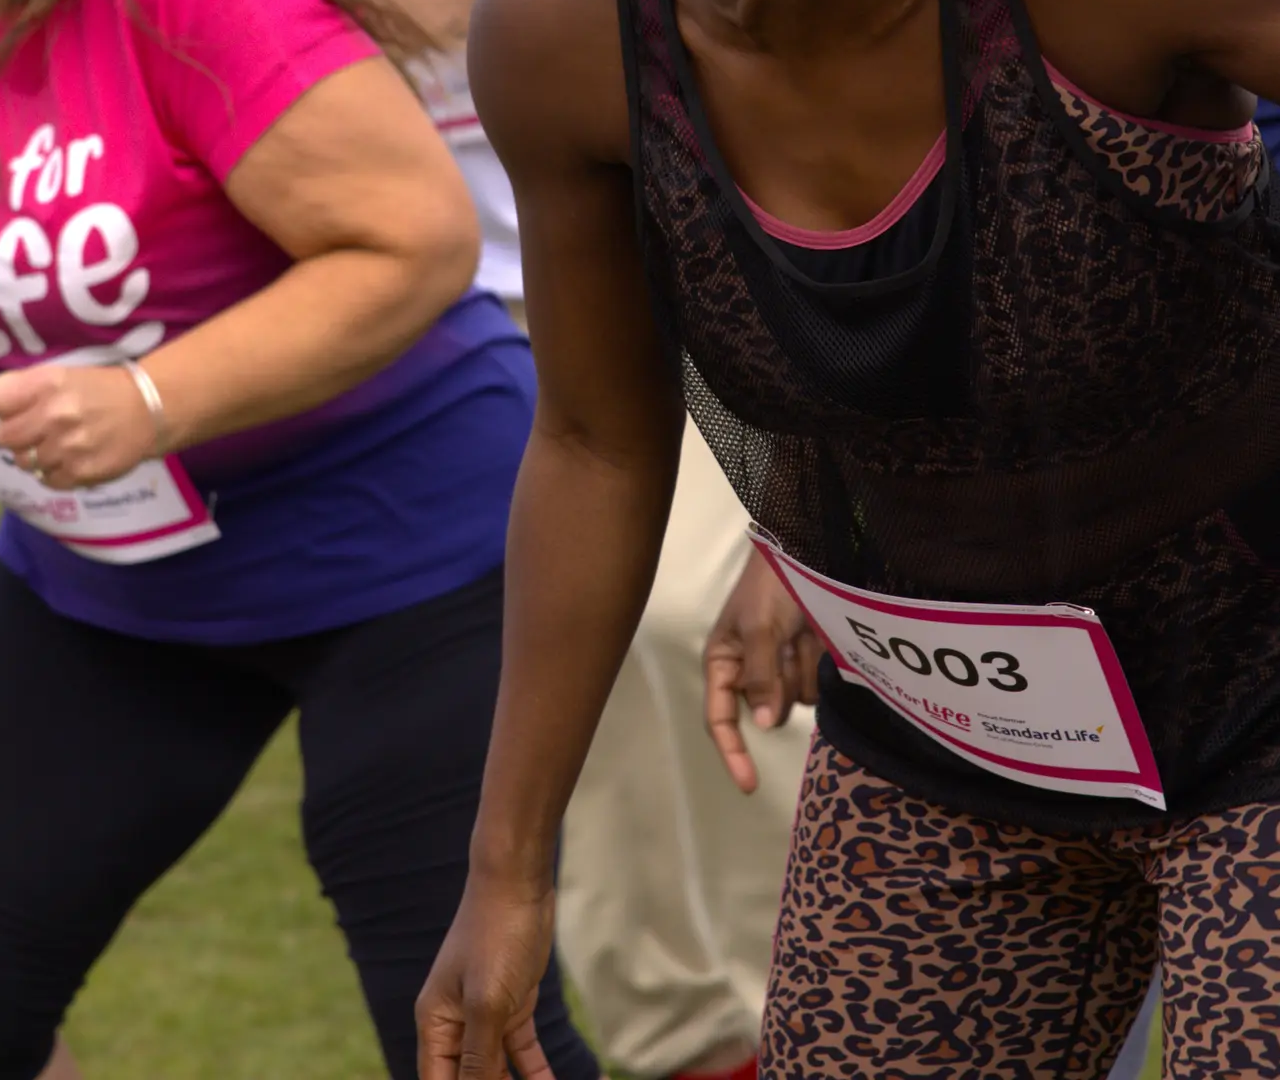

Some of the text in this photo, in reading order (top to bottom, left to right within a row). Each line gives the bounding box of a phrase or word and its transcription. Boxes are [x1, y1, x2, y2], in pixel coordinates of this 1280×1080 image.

[9, 123, 104, 212] for
[845, 616, 1030, 693] 5003
[893, 685, 922, 707] for
[921, 697, 972, 728] Life
[981, 721, 1062, 742] Standard
[1064, 729, 1100, 743] Life
